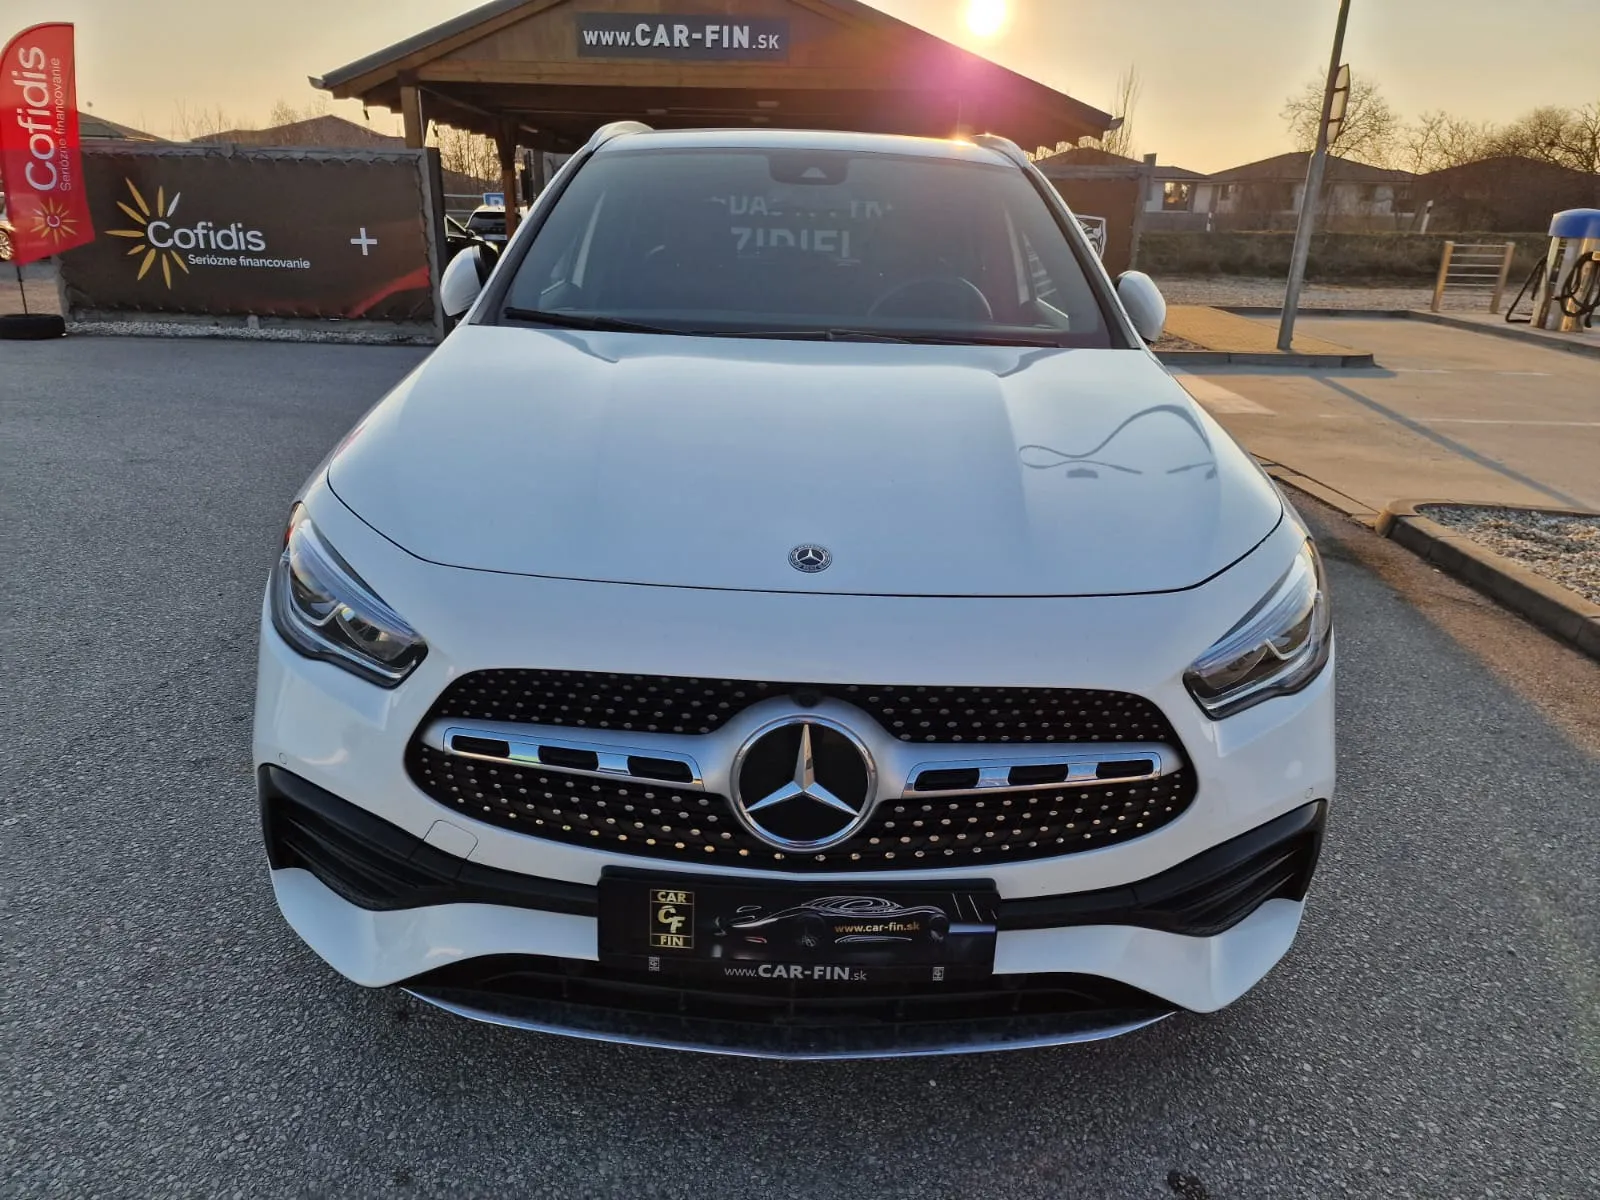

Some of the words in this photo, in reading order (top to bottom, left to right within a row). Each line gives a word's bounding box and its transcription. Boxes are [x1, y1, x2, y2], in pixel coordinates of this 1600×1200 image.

[50, 57, 67, 135] financovanie
[11, 46, 57, 191] Cofidis
[57, 134, 72, 192] Seriózne
[147, 221, 266, 252] Cofidis
[188, 254, 238, 266] Seriózne
[239, 256, 311, 269] financovanie
[656, 891, 687, 903] CAR
[834, 922, 920, 933] www.car-fin.sk
[660, 935, 684, 947] FIN
[724, 964, 868, 982] www.CAR-FIN.sk
